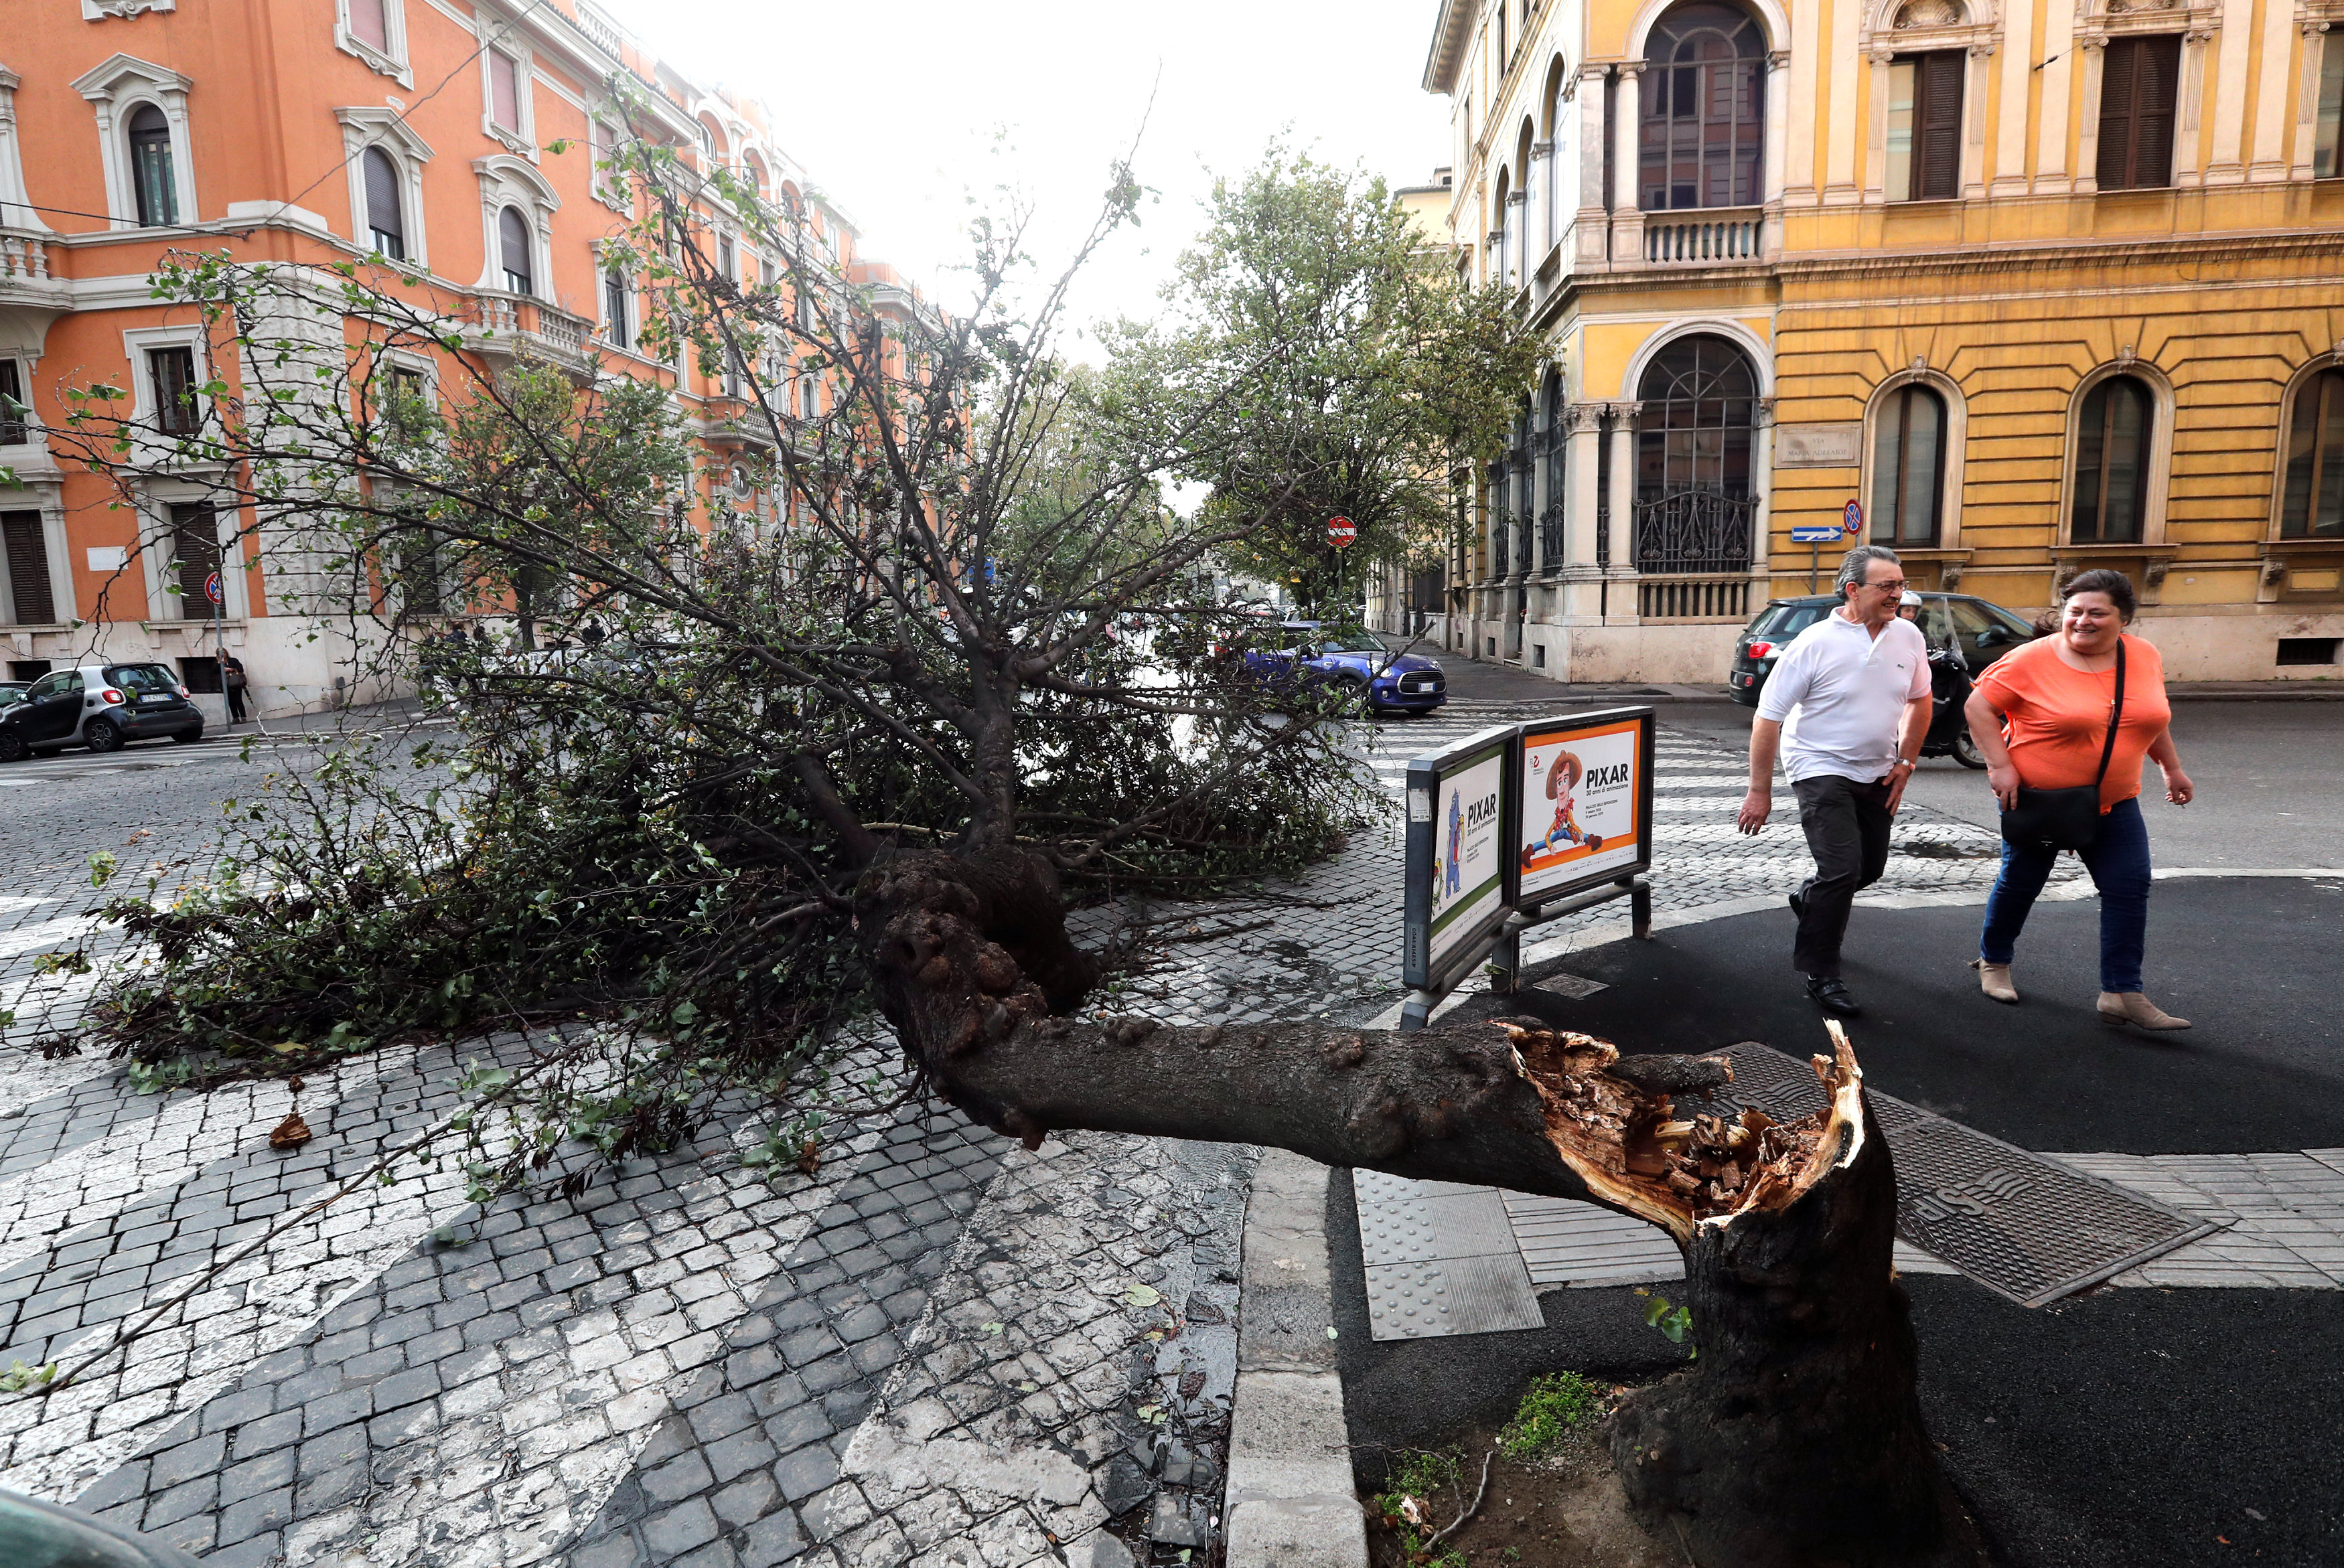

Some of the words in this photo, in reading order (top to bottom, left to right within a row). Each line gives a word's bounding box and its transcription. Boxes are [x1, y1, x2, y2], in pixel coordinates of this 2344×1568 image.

[1586, 763, 1629, 789] PIXAR
[1606, 783, 1629, 792] animazione
[1467, 793, 1496, 828] PIXAR
[1912, 1187, 1984, 1222] SIP
